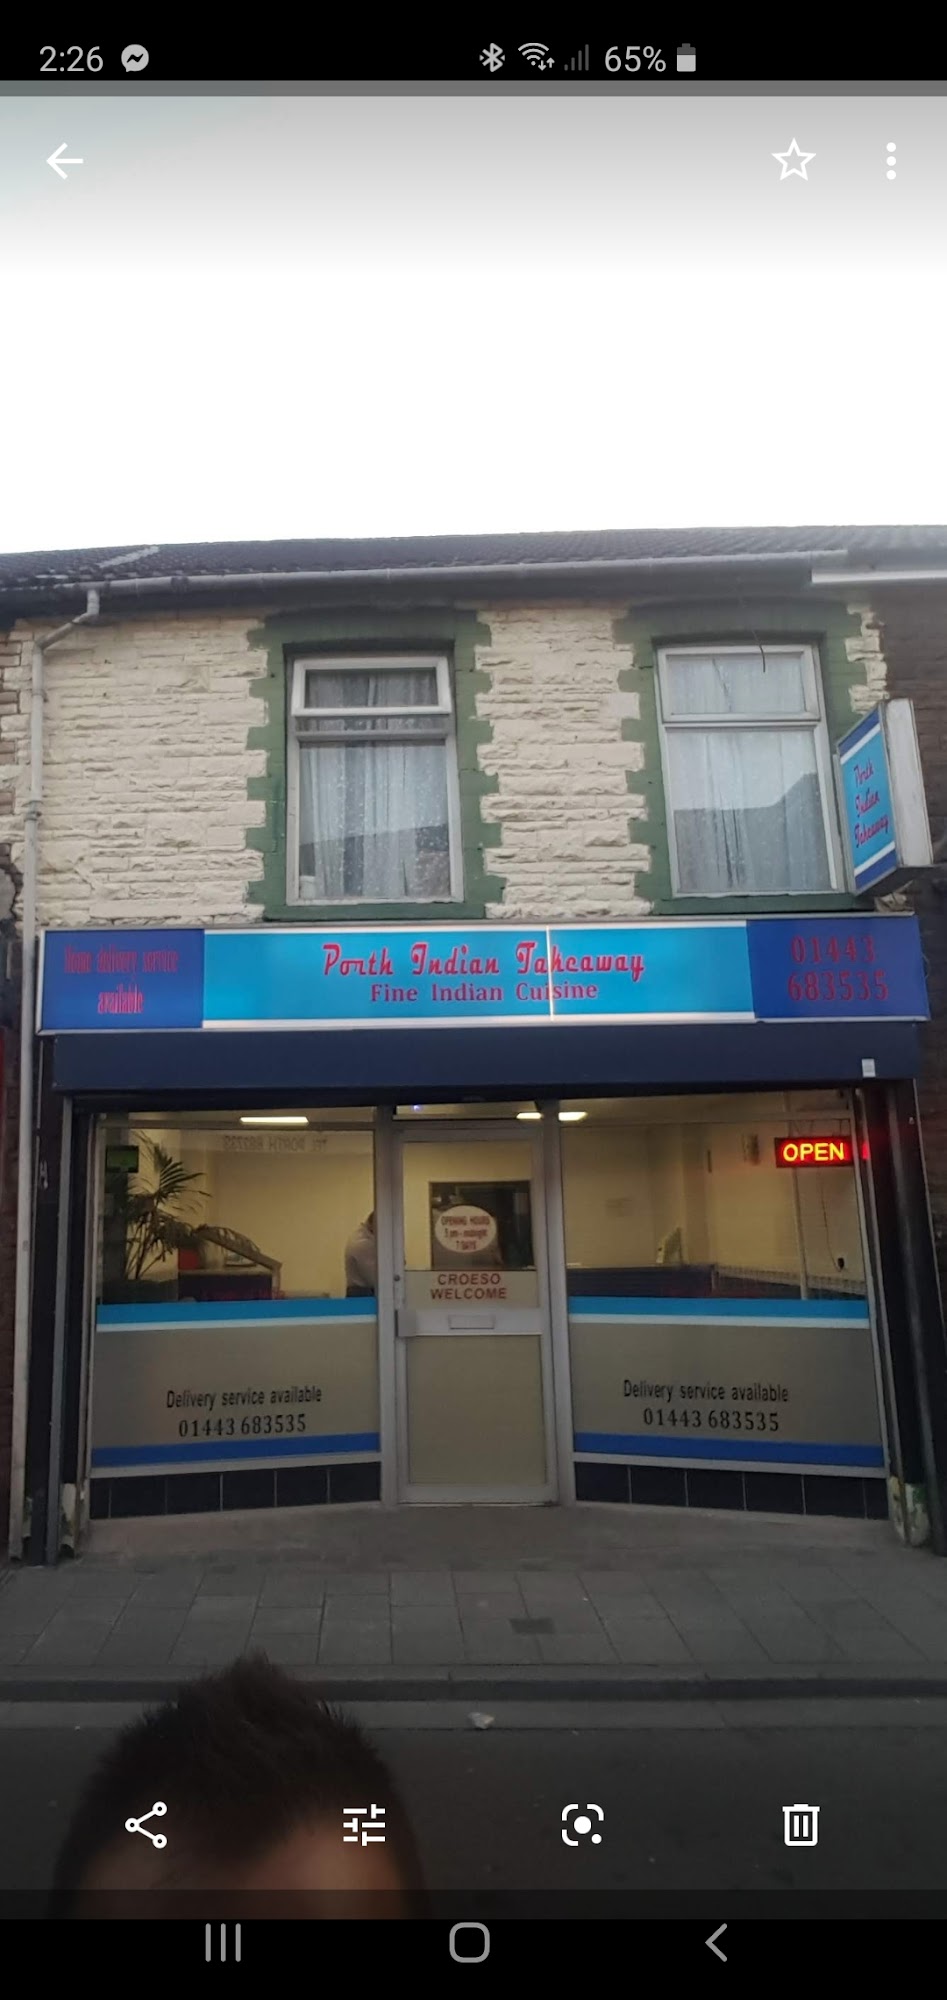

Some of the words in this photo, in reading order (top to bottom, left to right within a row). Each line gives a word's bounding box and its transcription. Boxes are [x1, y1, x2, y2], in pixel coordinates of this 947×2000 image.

[142, 947, 179, 974] service
[322, 943, 394, 976] Porth
[410, 942, 500, 976] Indian
[515, 941, 645, 982] Takeaway
[790, 934, 876, 964] 01443
[370, 983, 418, 1002] Fine
[431, 981, 503, 1002] Indian
[516, 980, 598, 1001] Cuisine
[787, 968, 889, 1002] 683535
[97, 984, 144, 1014] available
[783, 1142, 845, 1162] OPEN
[438, 1272, 502, 1286] CROESO
[431, 1287, 508, 1300] WELCOME
[166, 1389, 216, 1412] Delivery
[221, 1387, 265, 1407] service
[270, 1385, 322, 1404] available
[624, 1379, 673, 1403] Delivery
[680, 1381, 725, 1401] service
[732, 1382, 788, 1402] available
[179, 1417, 235, 1437] 01443
[241, 1413, 306, 1435] 683535
[643, 1407, 702, 1428] 01443
[708, 1409, 780, 1432] 683535
